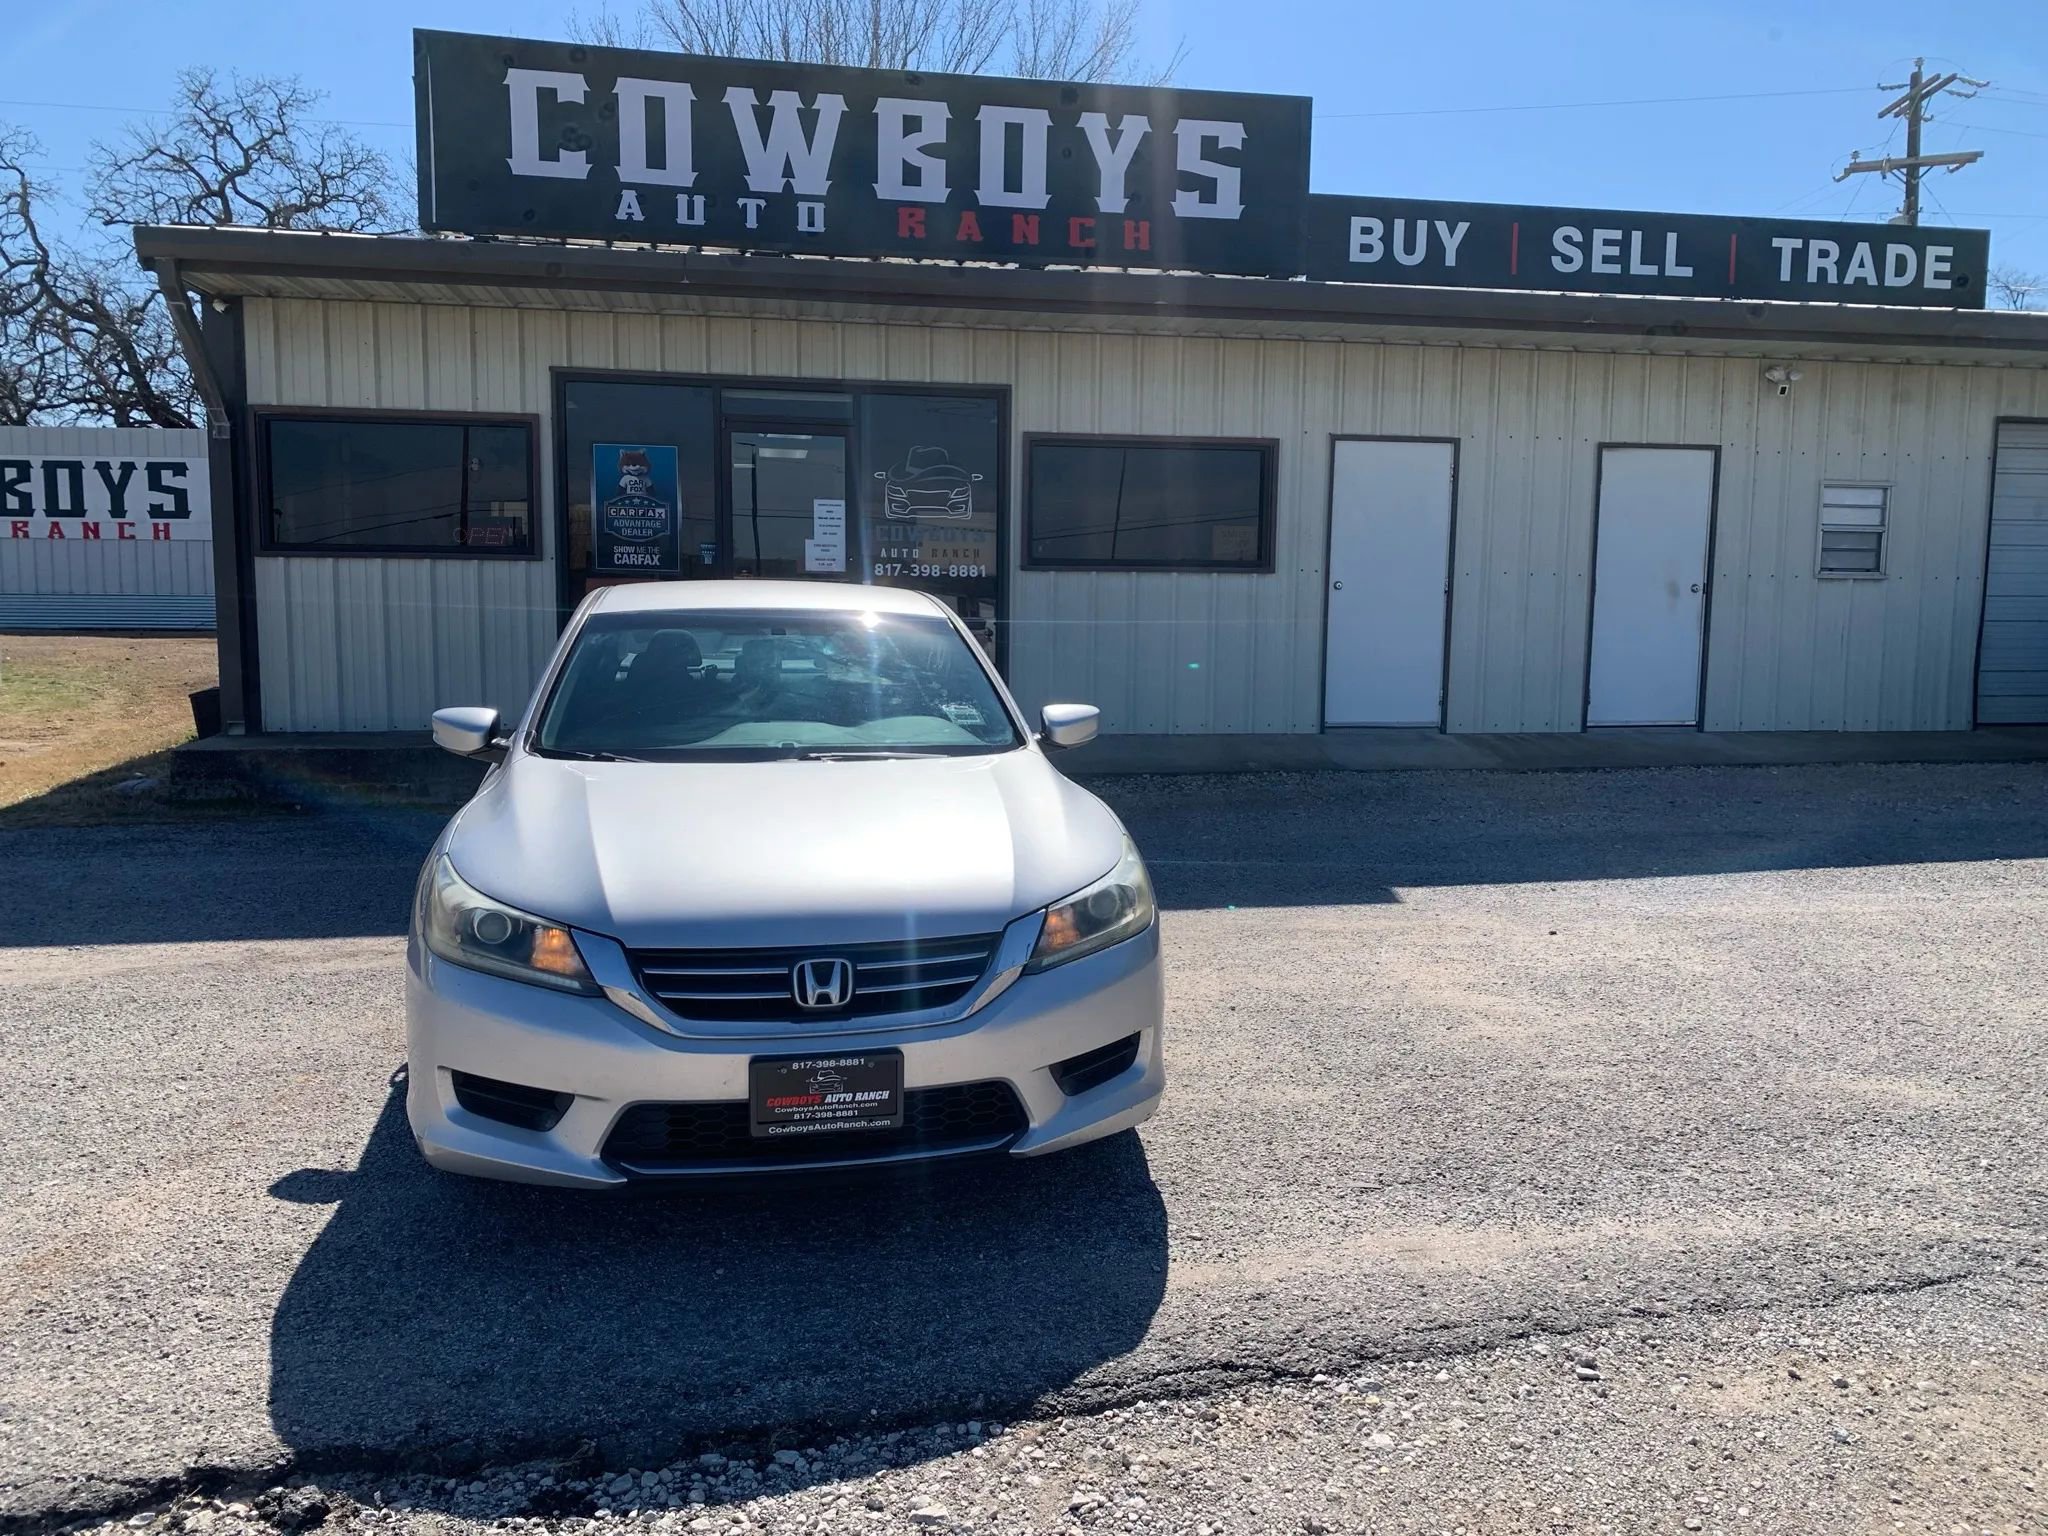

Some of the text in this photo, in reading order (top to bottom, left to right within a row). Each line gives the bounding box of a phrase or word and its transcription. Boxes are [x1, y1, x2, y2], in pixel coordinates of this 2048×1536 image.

[502, 67, 1249, 220] COWBOYS
[614, 188, 1153, 252] AUTO RANCH
[1348, 215, 1955, 290] BUY SELL TRADE
[0, 459, 193, 520] BOYS
[610, 507, 666, 519] CARFAX
[613, 518, 662, 528] ADVANTAGE
[11, 520, 171, 541] RANCH
[621, 527, 653, 537] DEALER
[613, 545, 660, 554] SHOW ME THE
[880, 547, 980, 559] AUTO RANCH
[613, 553, 661, 565] CARFAX
[874, 563, 987, 578] 817-398-8881
[792, 1058, 865, 1070] 817-398-8881
[766, 1090, 890, 1107] COWBOYS AUTO RANCH
[774, 1101, 878, 1113] CowboysAutoRanch.com
[793, 1109, 858, 1120] 817-398-8881
[768, 1119, 891, 1134] CowboysAutoRanch.com
